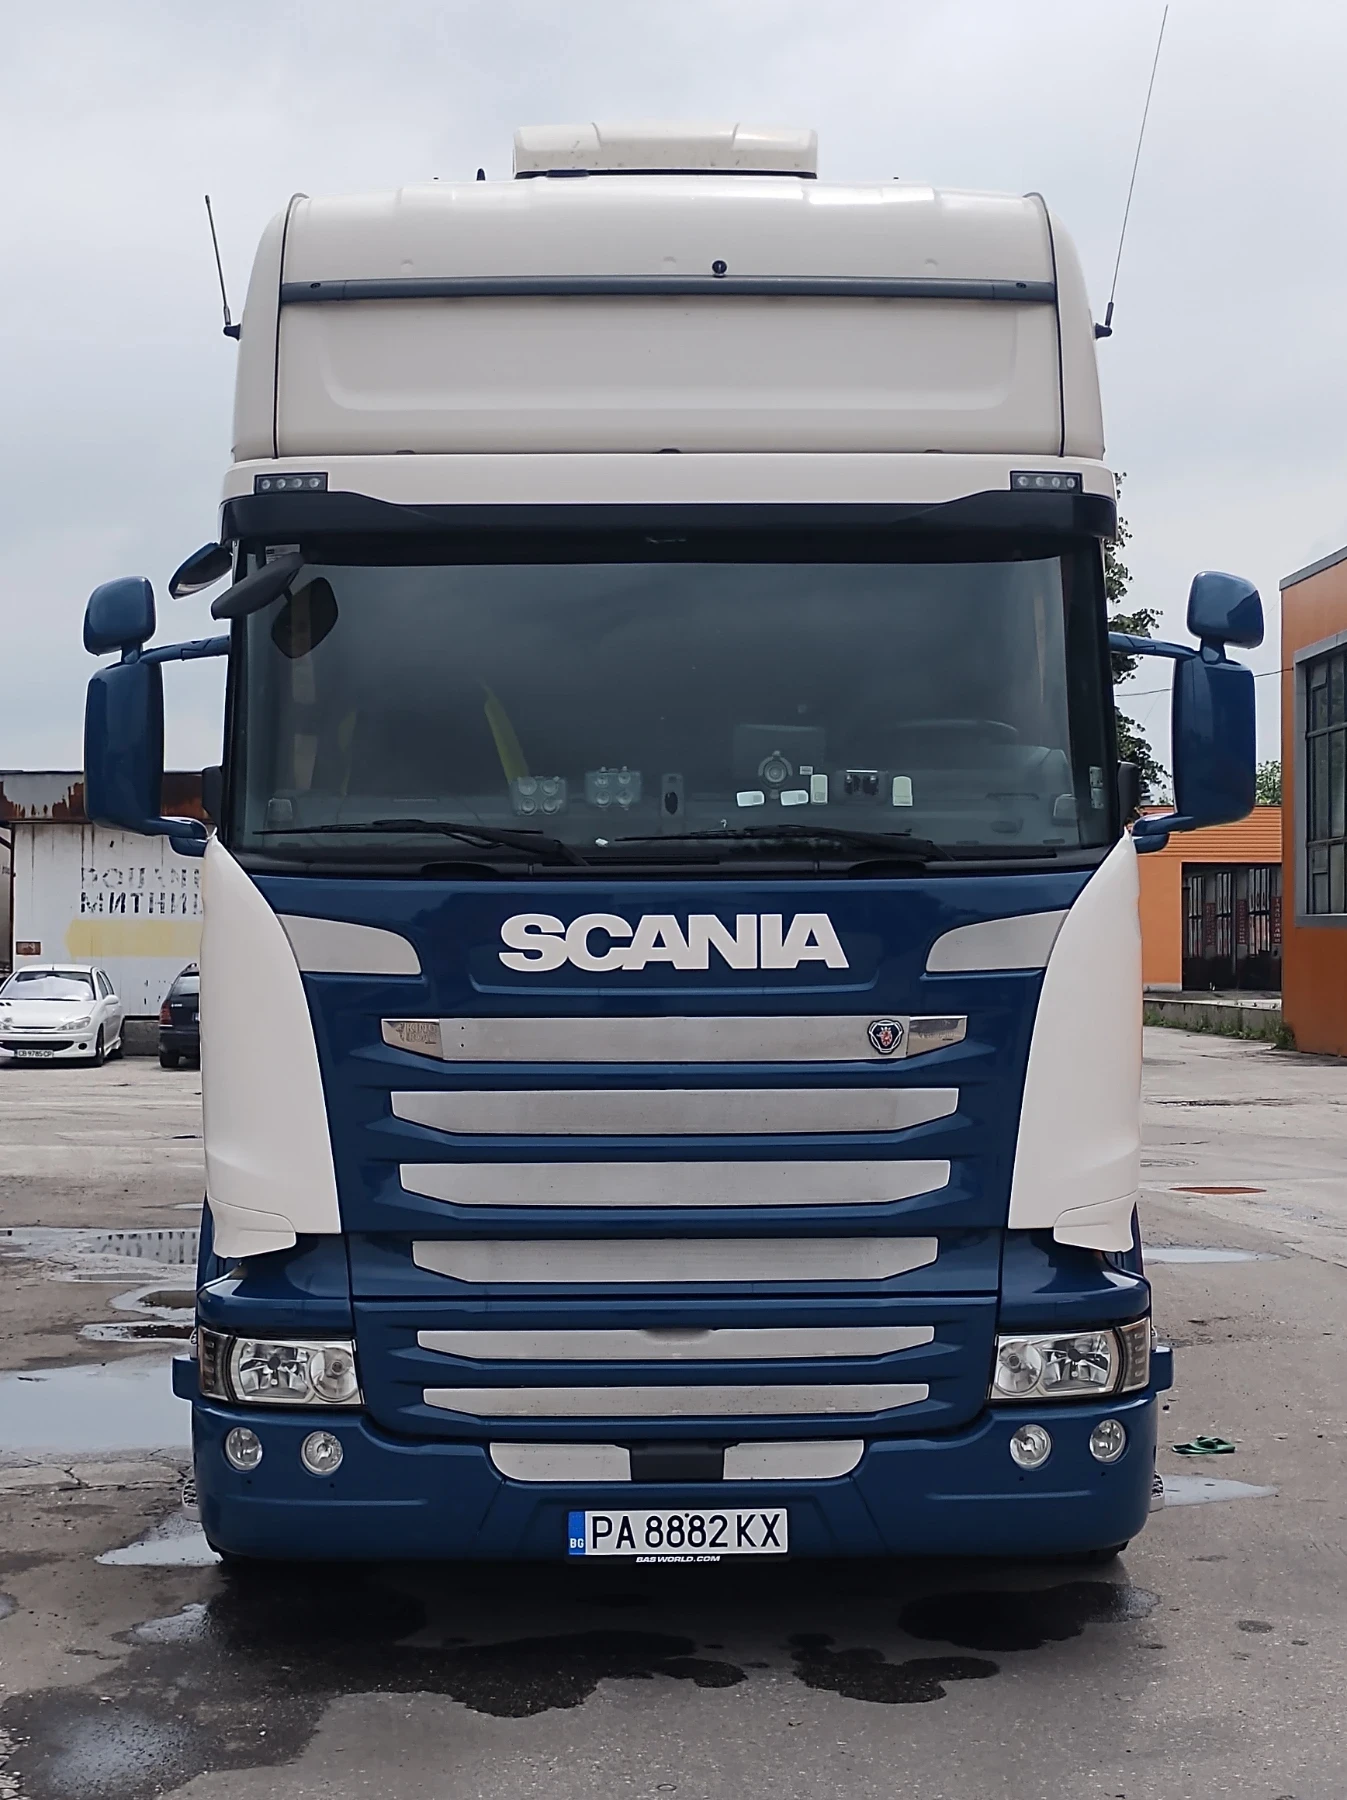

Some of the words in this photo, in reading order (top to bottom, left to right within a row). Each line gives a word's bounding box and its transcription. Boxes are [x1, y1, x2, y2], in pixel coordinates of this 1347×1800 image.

[499, 914, 849, 972] SCANIA
[570, 1538, 585, 1549] BG
[592, 1516, 636, 1549] PA
[645, 1514, 729, 1548] 8882
[736, 1513, 782, 1548] KX
